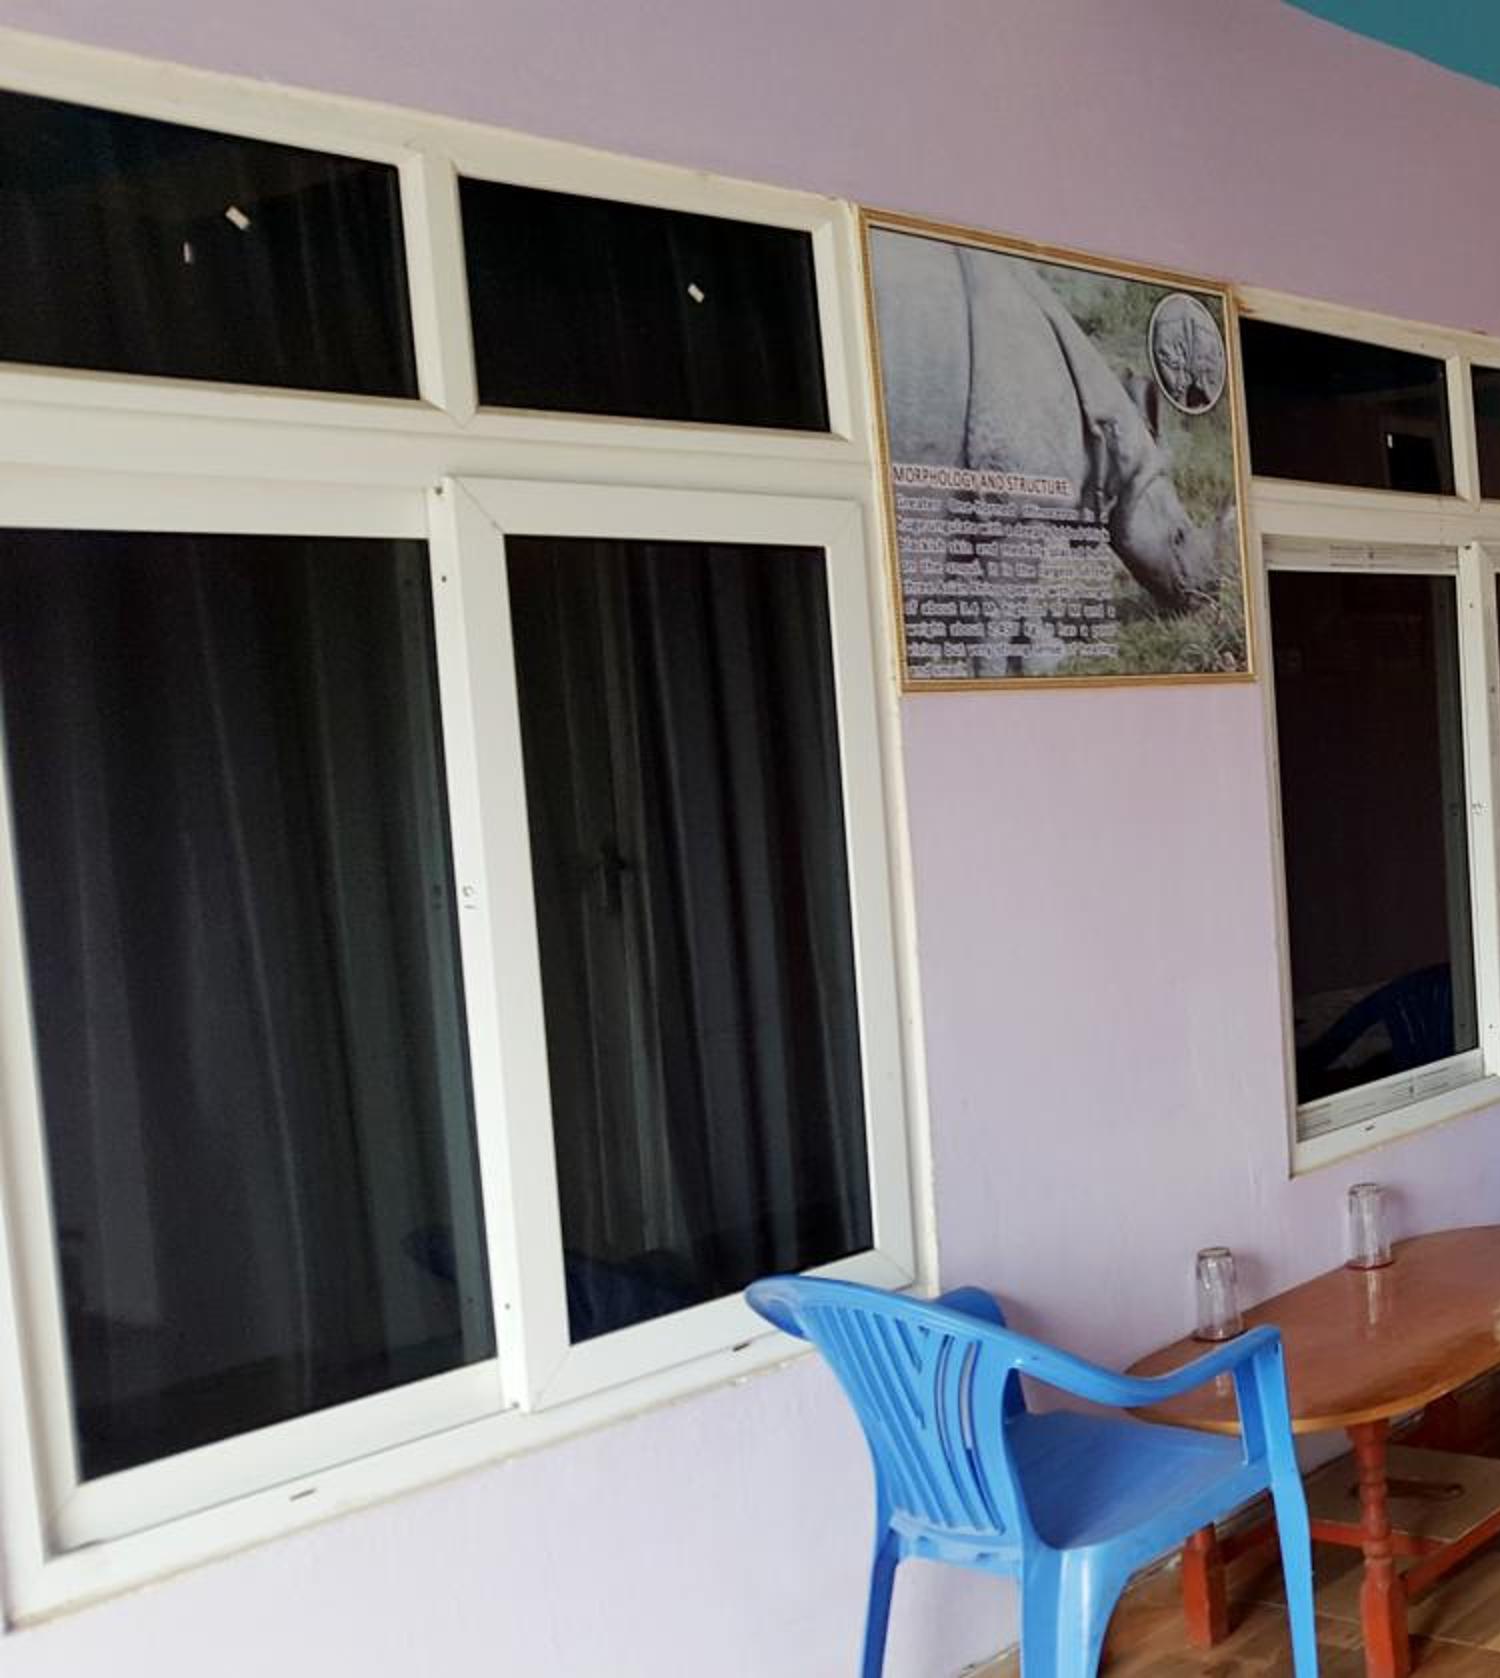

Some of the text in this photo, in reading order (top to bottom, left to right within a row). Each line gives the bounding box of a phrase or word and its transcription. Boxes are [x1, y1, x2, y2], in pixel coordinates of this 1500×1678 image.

[893, 465, 1068, 496] MORPHOLOGY AND STRUCTURE
